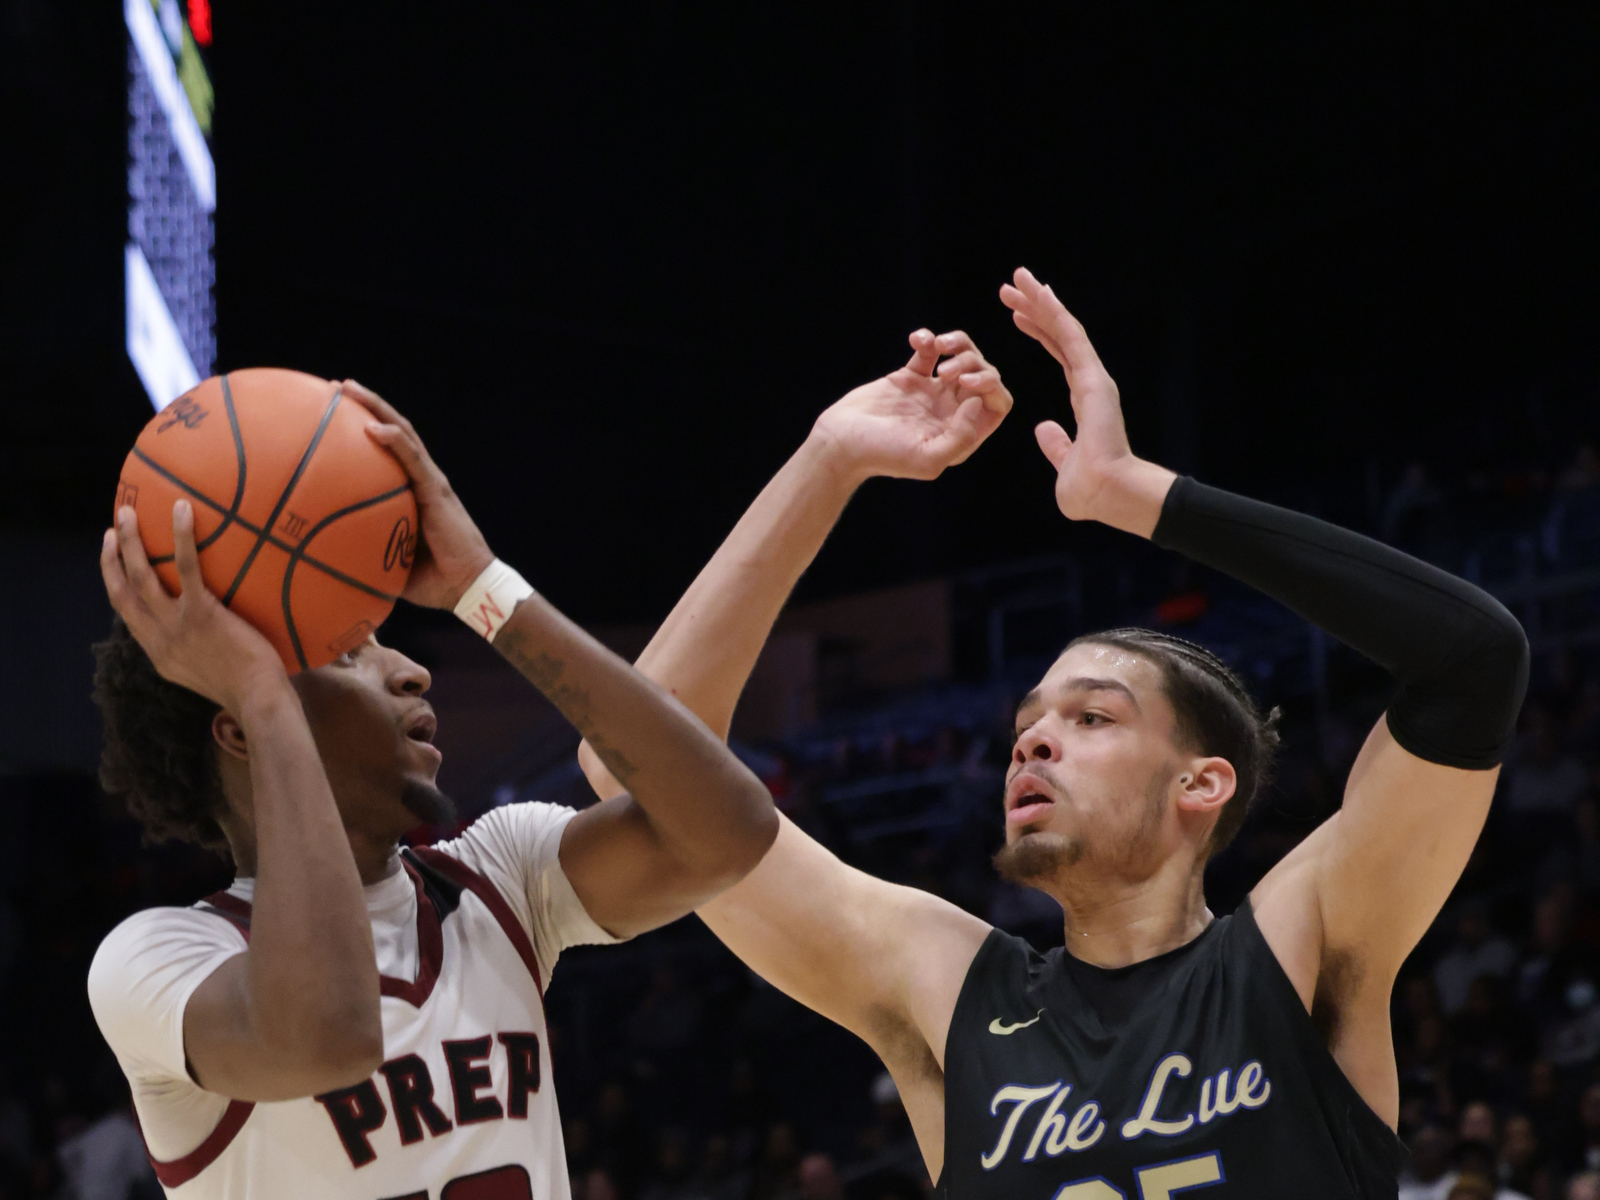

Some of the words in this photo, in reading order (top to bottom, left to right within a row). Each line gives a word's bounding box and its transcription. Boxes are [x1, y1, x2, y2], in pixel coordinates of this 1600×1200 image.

[313, 1030, 541, 1169] PREP
[981, 1078, 1107, 1171] The
[1119, 1050, 1271, 1140] Lue
